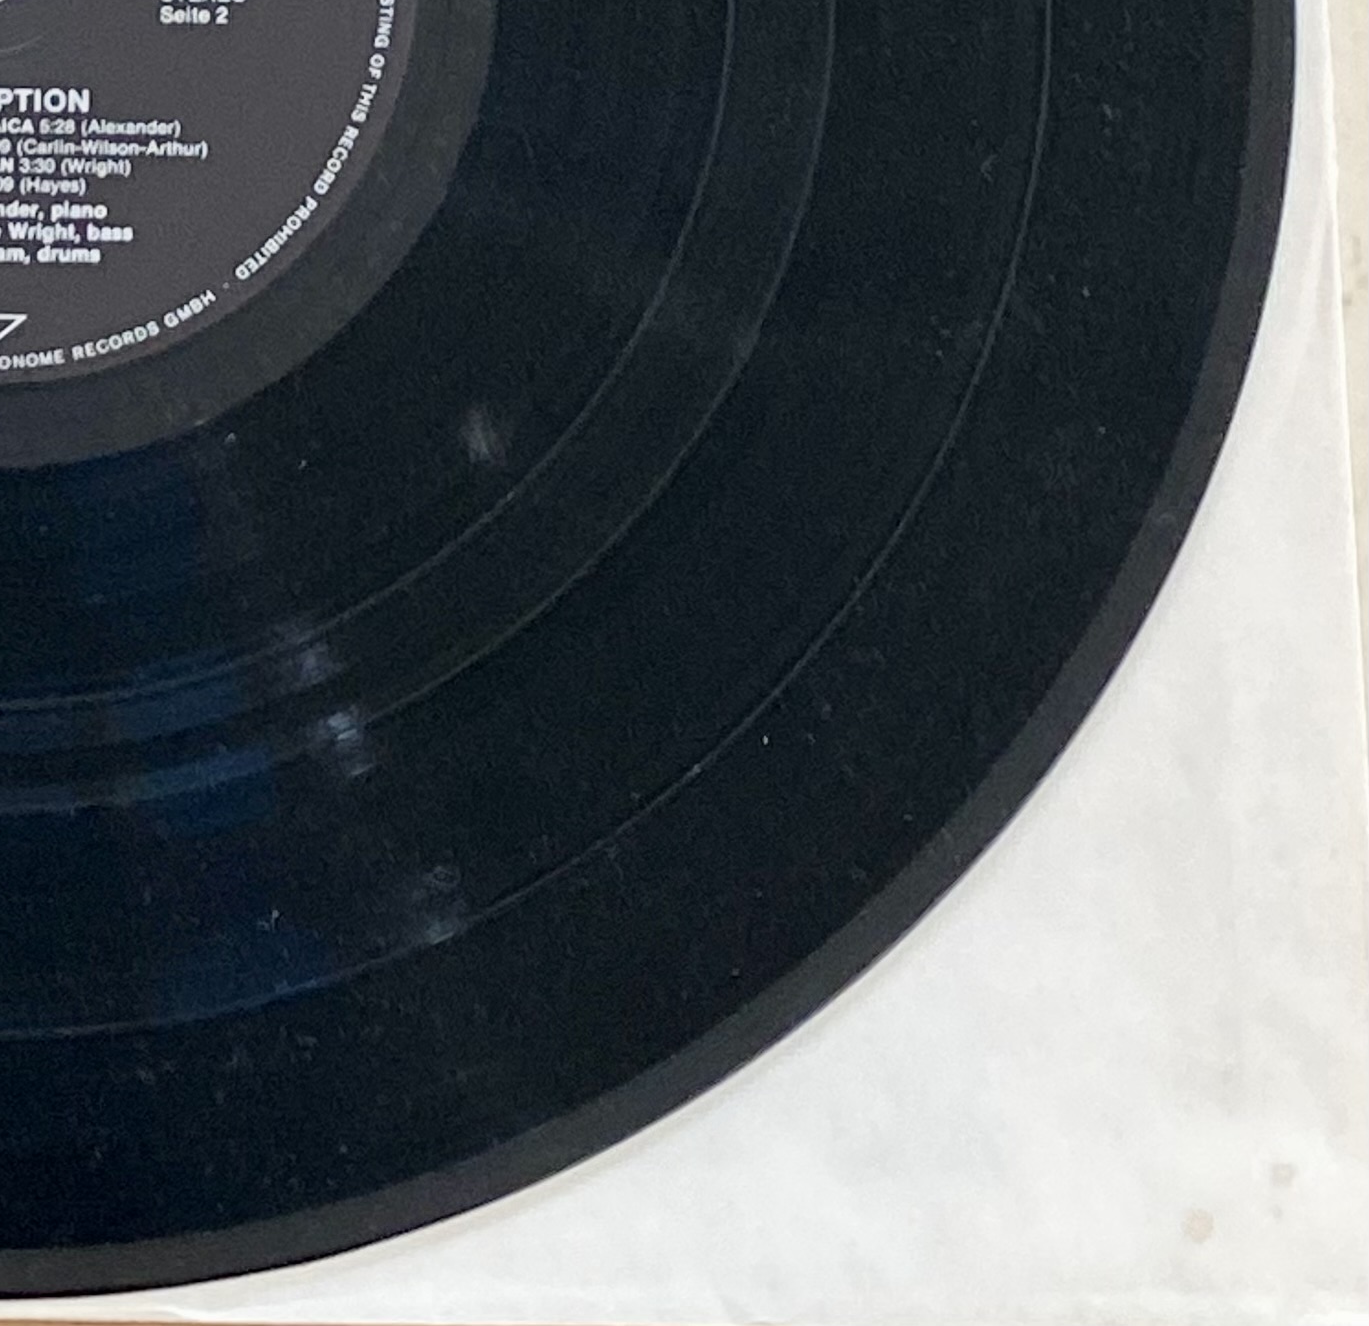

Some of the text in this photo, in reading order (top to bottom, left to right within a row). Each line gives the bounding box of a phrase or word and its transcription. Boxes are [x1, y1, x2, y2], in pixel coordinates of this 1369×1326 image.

[159, 5, 229, 25] Seite 2
[368, 53, 385, 80] OF
[350, 84, 378, 123] THIS
[80, 119, 181, 138] (Alexander)
[60, 159, 132, 178] (Wright)
[313, 125, 359, 195] RECORD
[19, 178, 86, 197] (Hayes)
[50, 201, 108, 222] piano
[7, 220, 81, 244] Wright,
[86, 223, 134, 242] bass
[235, 195, 318, 280] PROHIBITED
[36, 245, 101, 264] drums
[71, 320, 160, 361] RECORDS
[163, 289, 216, 328] GMBH
